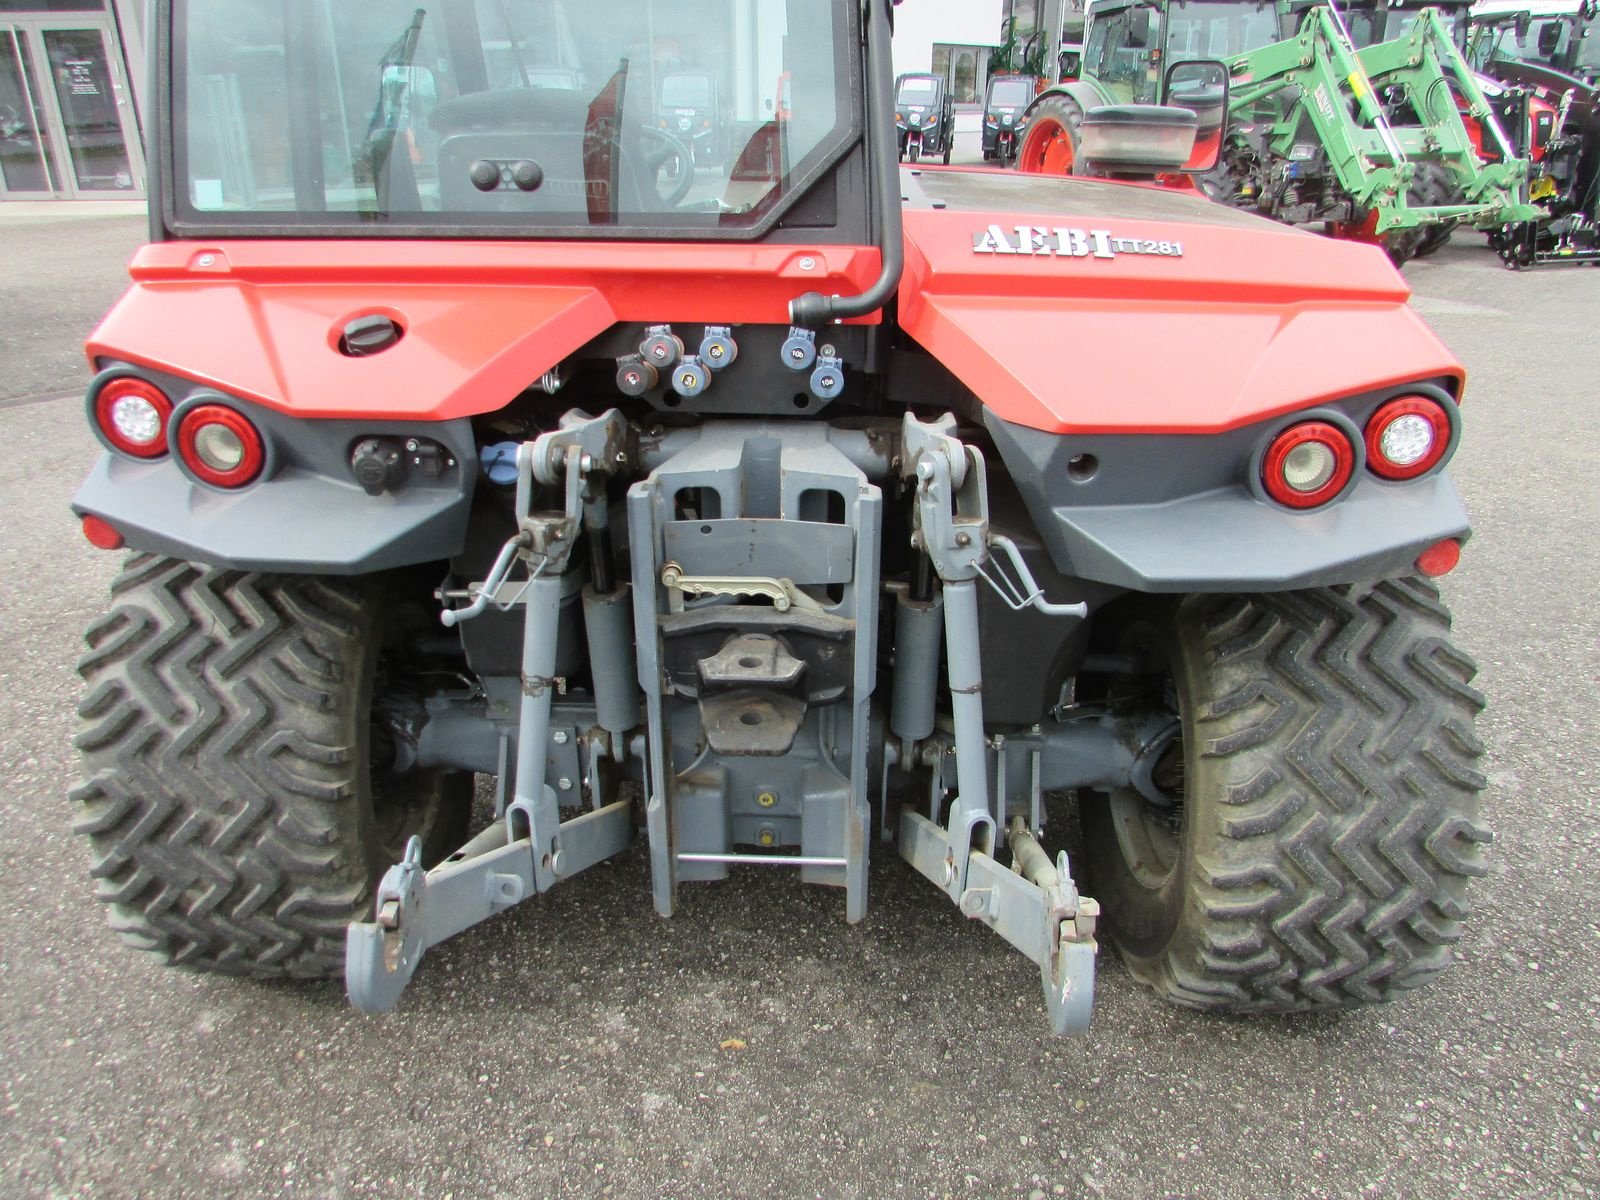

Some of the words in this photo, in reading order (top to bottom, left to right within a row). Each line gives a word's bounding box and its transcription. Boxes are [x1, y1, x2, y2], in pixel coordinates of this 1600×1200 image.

[973, 224, 1114, 259] AEBI
[1113, 238, 1183, 257] TT281
[792, 350, 803, 358] 10b
